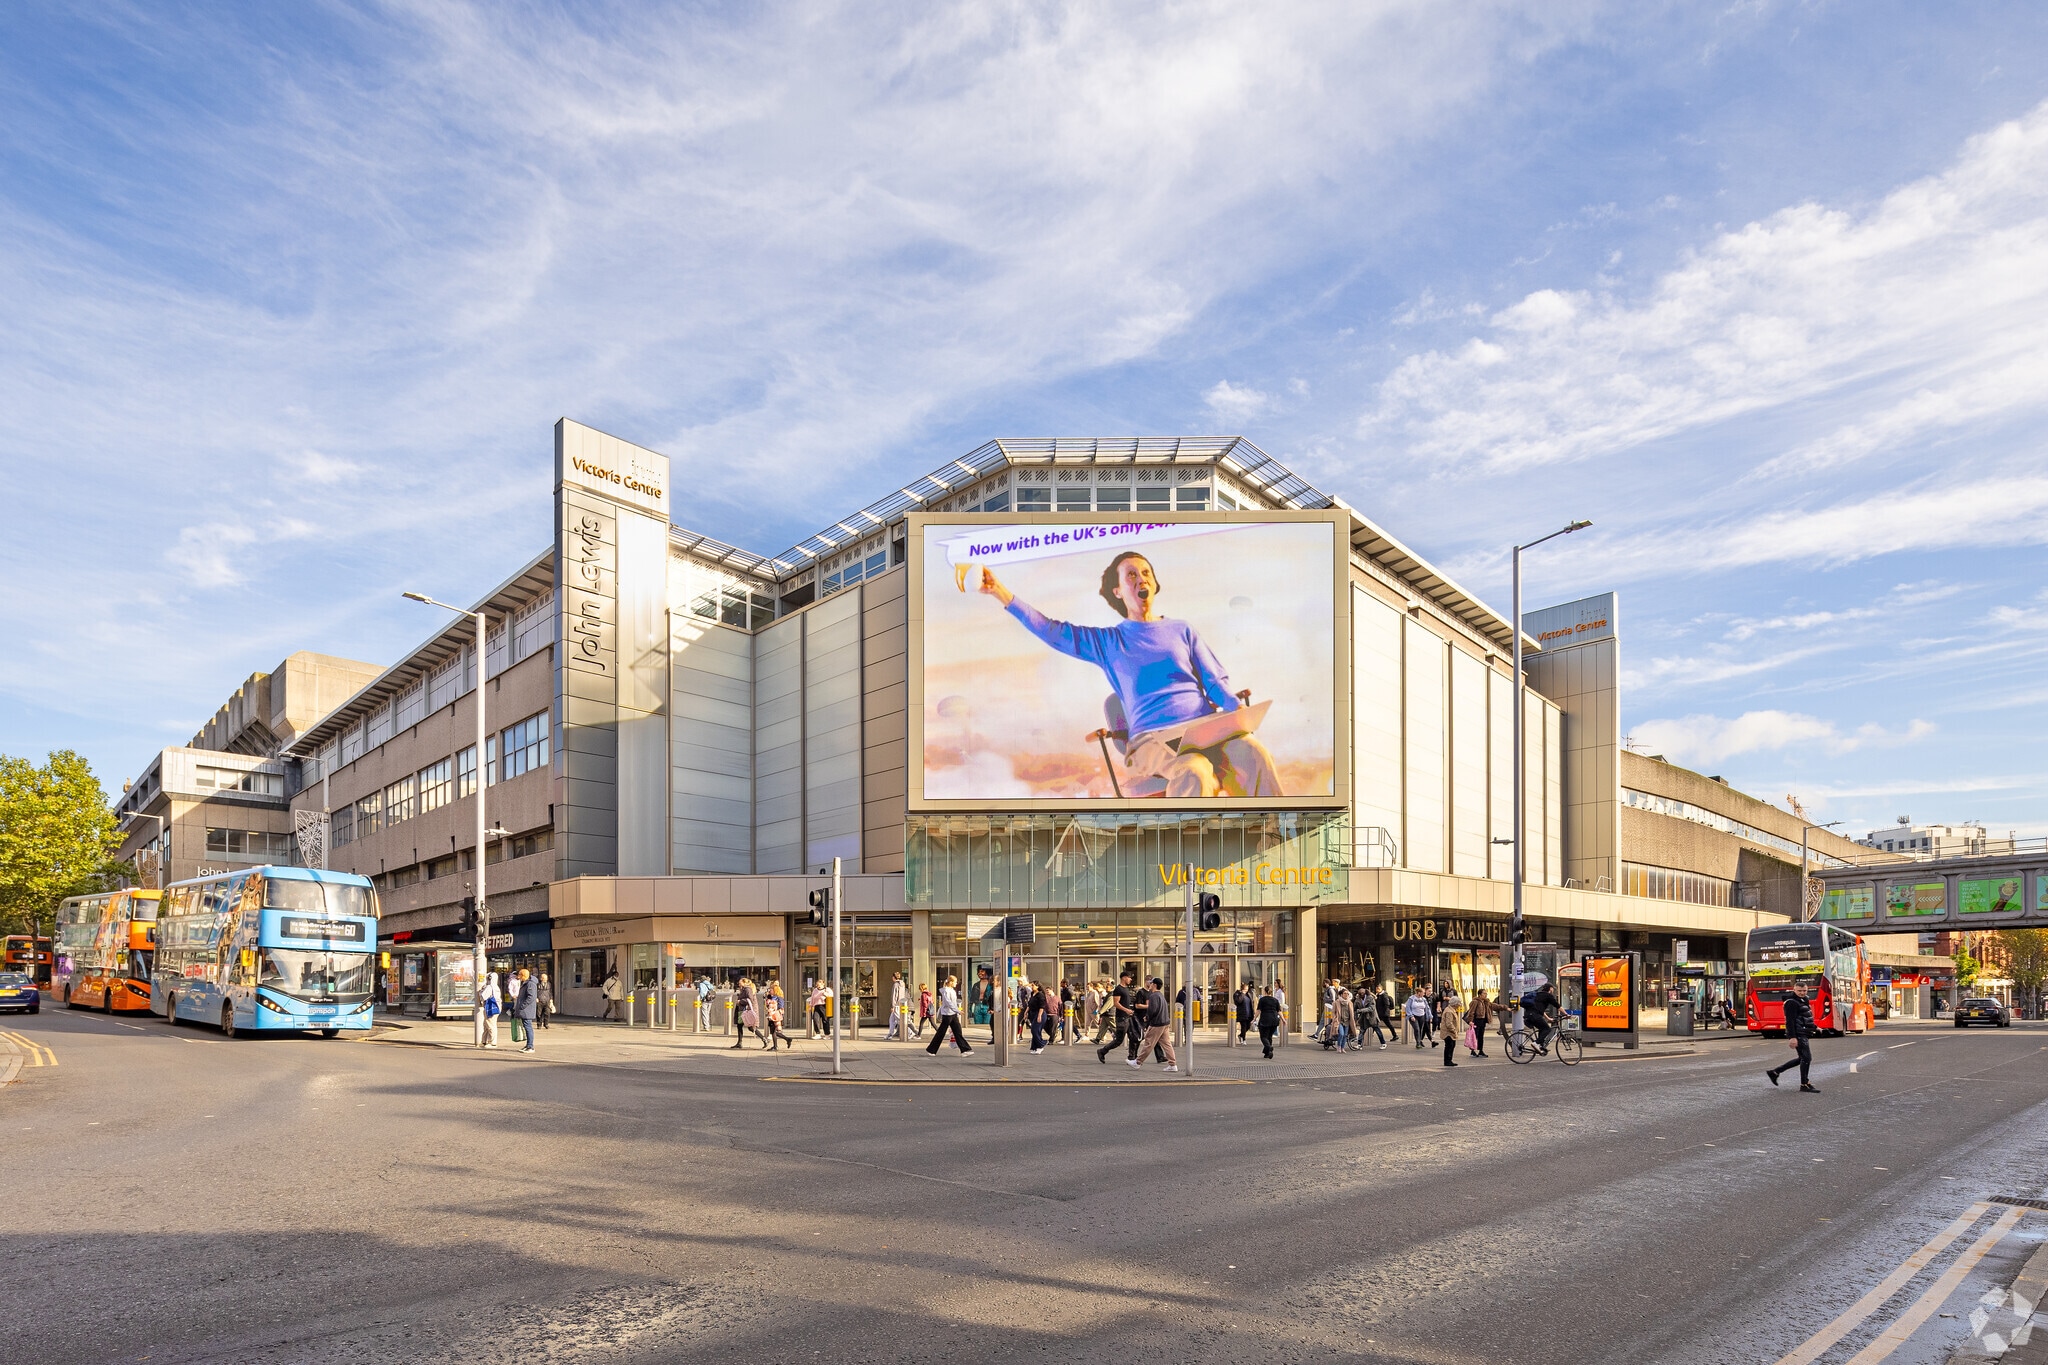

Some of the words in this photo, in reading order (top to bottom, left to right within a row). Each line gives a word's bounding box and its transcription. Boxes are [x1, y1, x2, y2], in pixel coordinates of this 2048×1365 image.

[572, 456, 621, 485] Victoria
[623, 475, 662, 499] Centre
[969, 542, 1003, 556] Now
[1006, 535, 1040, 552] with
[1043, 531, 1069, 546] the
[1073, 525, 1107, 541] UK's
[1110, 523, 1142, 535] only
[571, 515, 602, 595] Lewis
[571, 600, 606, 671] John
[1538, 627, 1572, 641] Victoria
[1575, 619, 1607, 632] Centre
[195, 865, 223, 878] John
[1255, 862, 1332, 885] Centre
[344, 924, 356, 937] 60
[1469, 921, 1533, 942] OUTFITS
[1593, 997, 1623, 1007] Reese's
